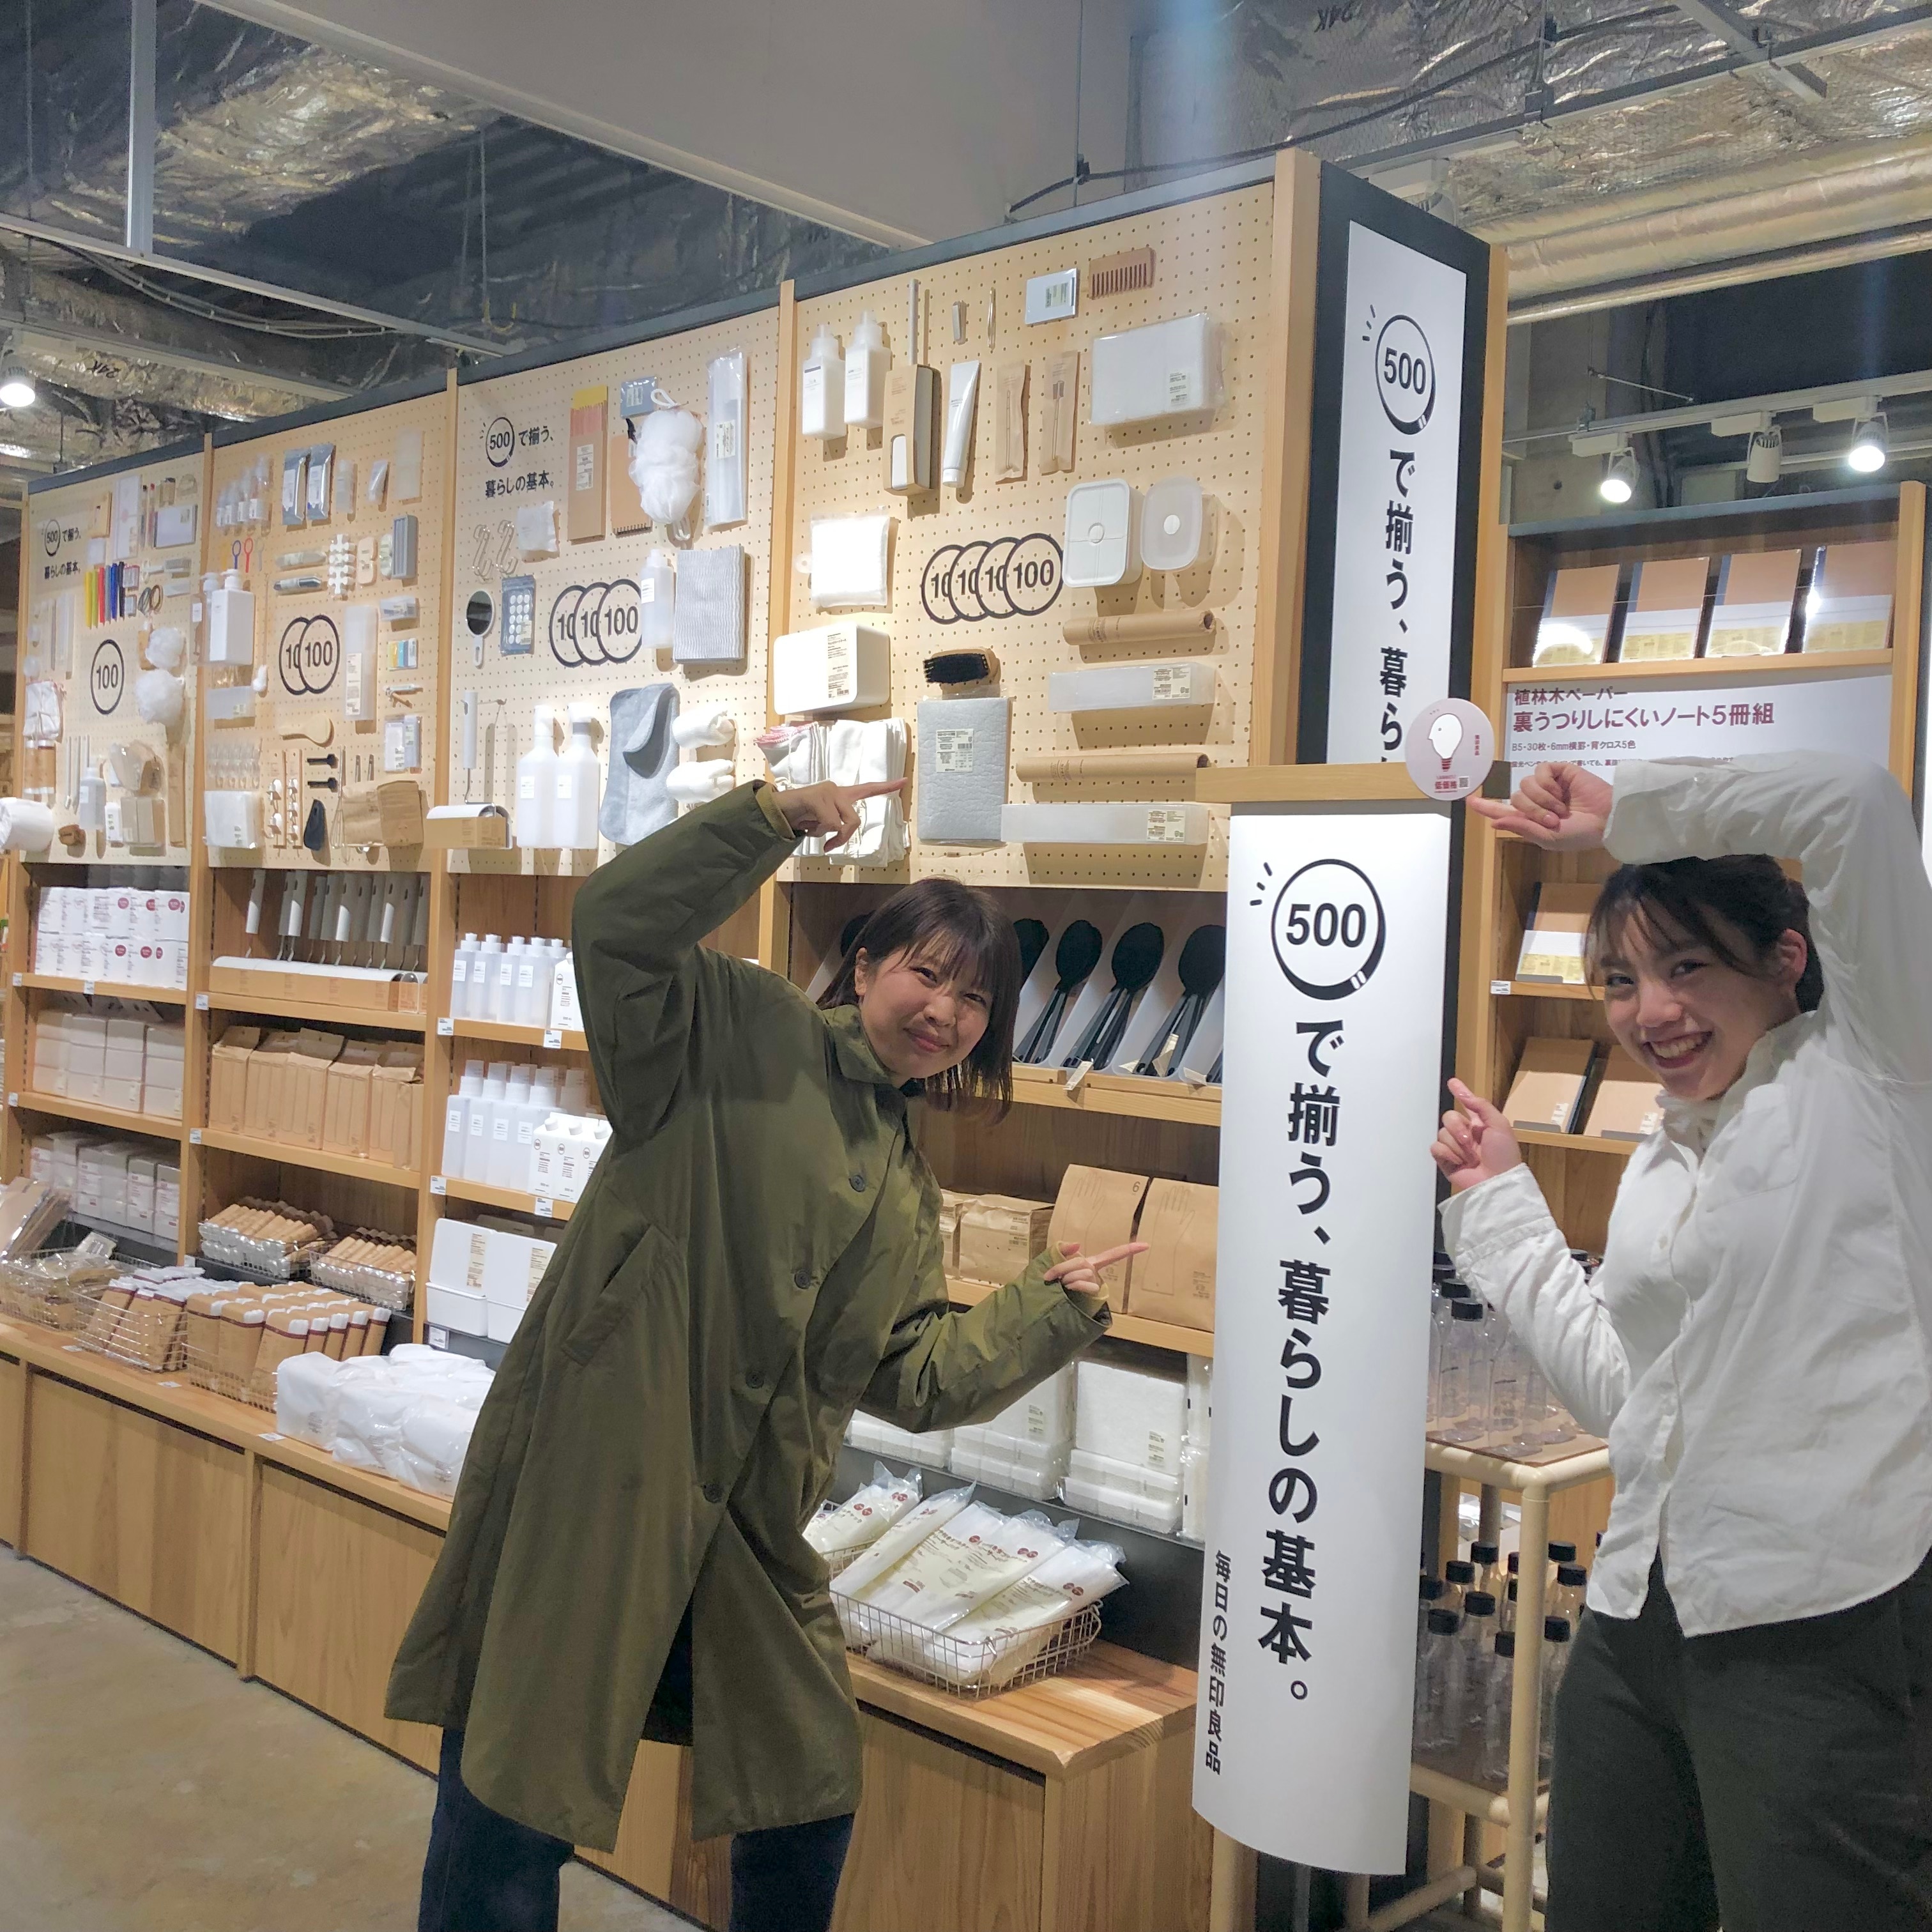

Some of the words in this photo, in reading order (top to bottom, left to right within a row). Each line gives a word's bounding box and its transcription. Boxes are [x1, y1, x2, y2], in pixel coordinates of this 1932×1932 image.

[1384, 347, 1426, 395] 500
[489, 431, 510, 450] 500
[486, 470, 554, 498] 暮らしの基本。
[1013, 559, 1054, 590] 100
[1379, 449, 1416, 762] で揃う、暮ら
[604, 606, 638, 636] 100
[305, 640, 332, 668] 100
[96, 664, 119, 690] 100
[1514, 686, 1628, 706] 植林木ペーパー
[1512, 702, 1775, 733] 裏うつりしにくいノート5冊組
[1285, 902, 1367, 948] 500
[1132, 1181, 1140, 1193] 6
[1257, 1019, 1344, 1701] で揃う、暮らしの基本。
[1205, 1549, 1232, 1775] 毎日の無印良品
